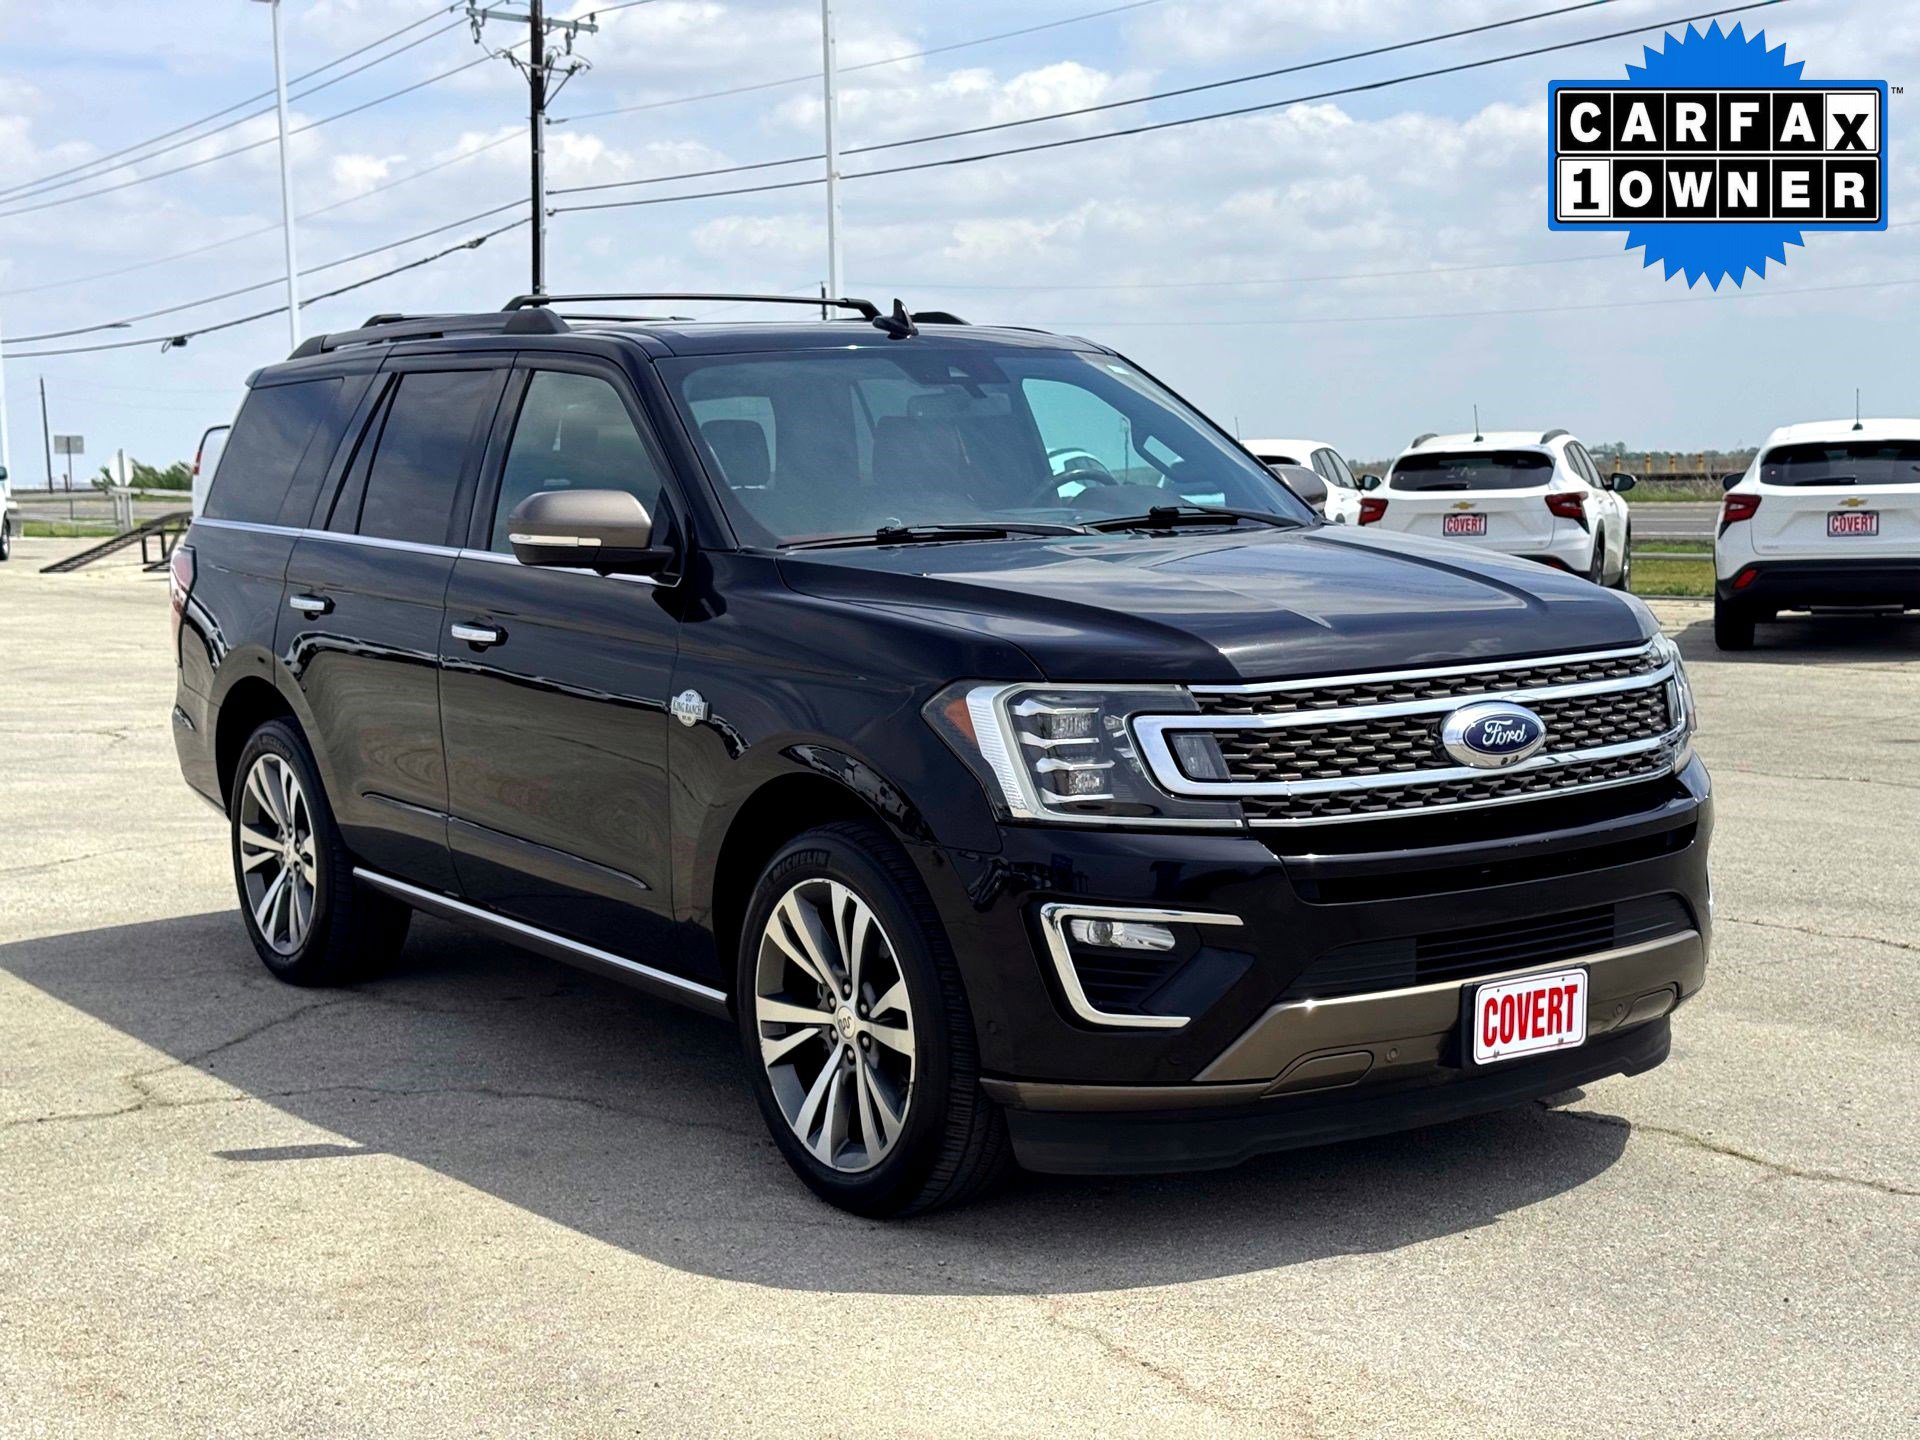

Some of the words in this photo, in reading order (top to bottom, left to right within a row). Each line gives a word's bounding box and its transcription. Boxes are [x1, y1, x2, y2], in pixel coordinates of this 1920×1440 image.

[1446, 517, 1482, 532] COVERT
[1831, 515, 1874, 532] COVERT
[1482, 720, 1527, 747] Ford
[1483, 984, 1578, 1047] COVERT
